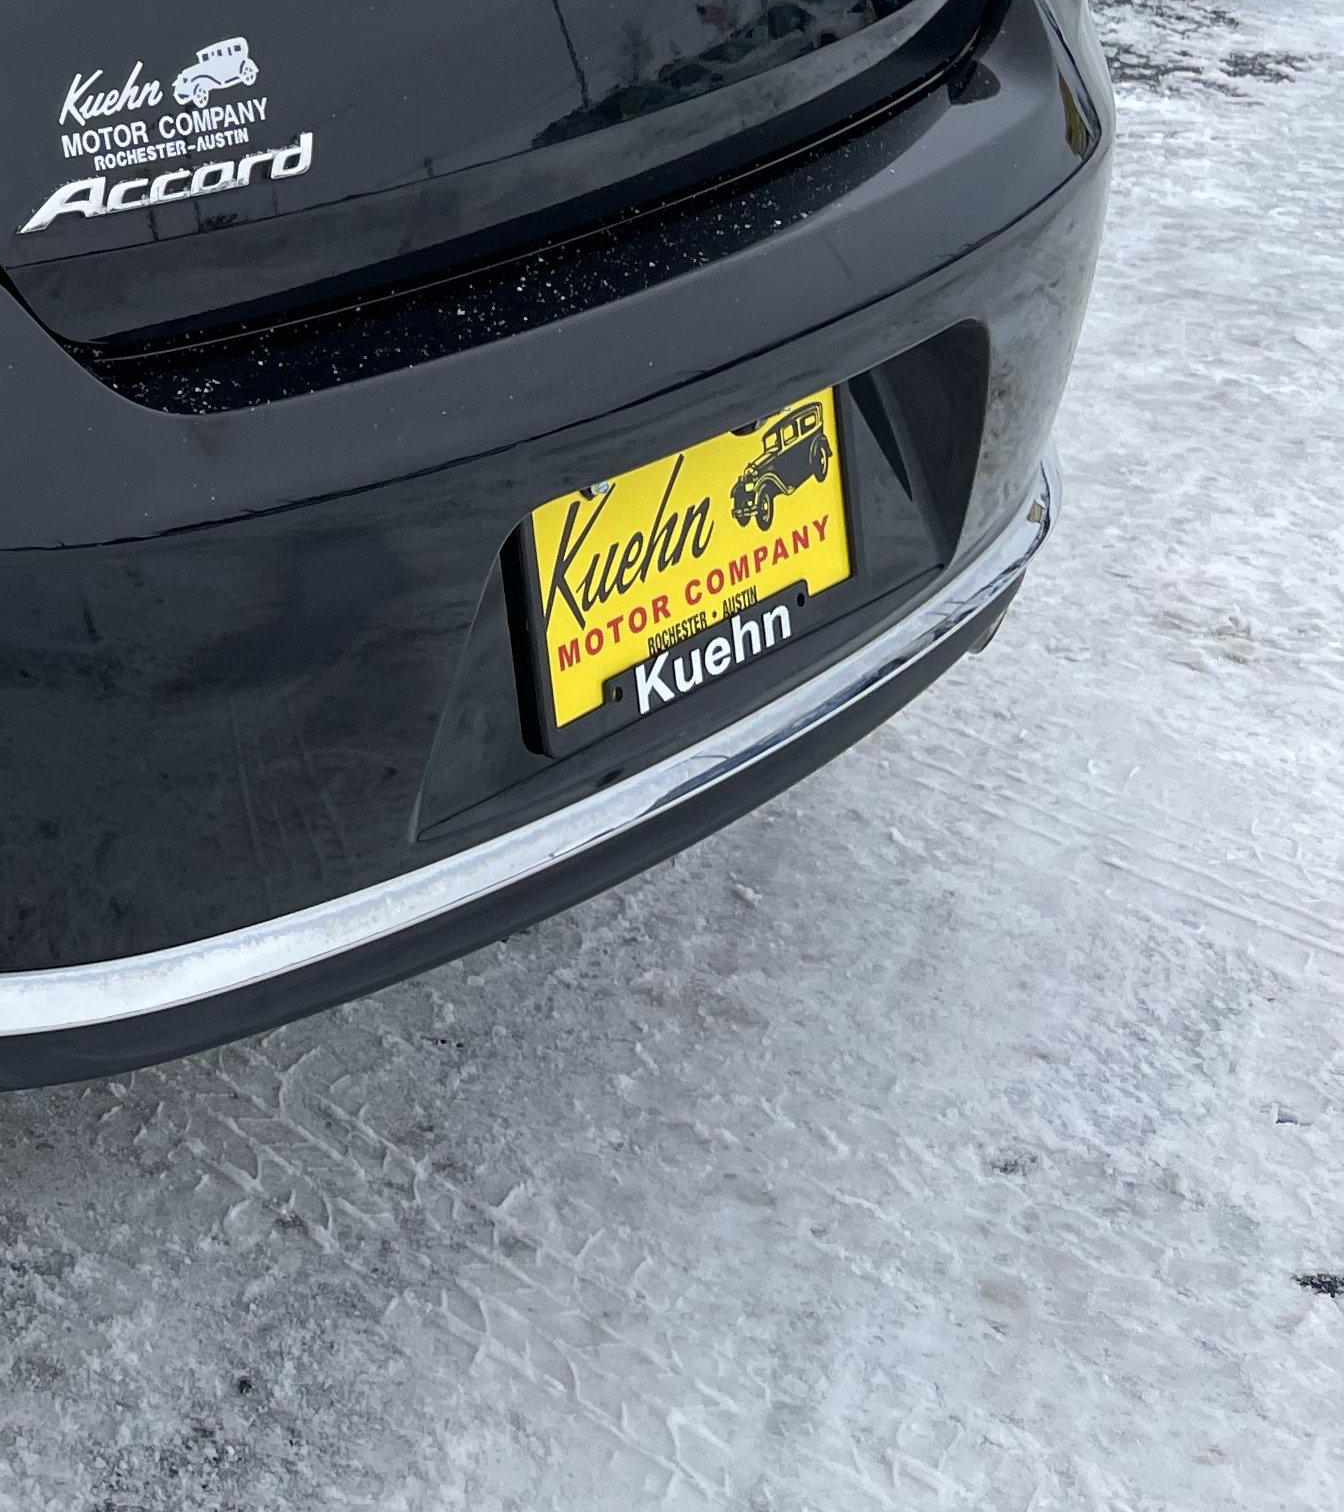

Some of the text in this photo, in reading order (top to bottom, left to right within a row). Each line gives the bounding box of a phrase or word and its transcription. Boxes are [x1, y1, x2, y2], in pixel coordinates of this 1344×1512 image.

[59, 60, 163, 126] Kuehn
[61, 97, 268, 158] MOTOR COMPANY
[16, 131, 313, 235] Accord
[543, 453, 715, 631] Kuehn
[556, 514, 830, 672] MOTOR COMPANY
[634, 603, 792, 716] Kuehn
[647, 585, 759, 658] ROCHESTER AUSTIN
